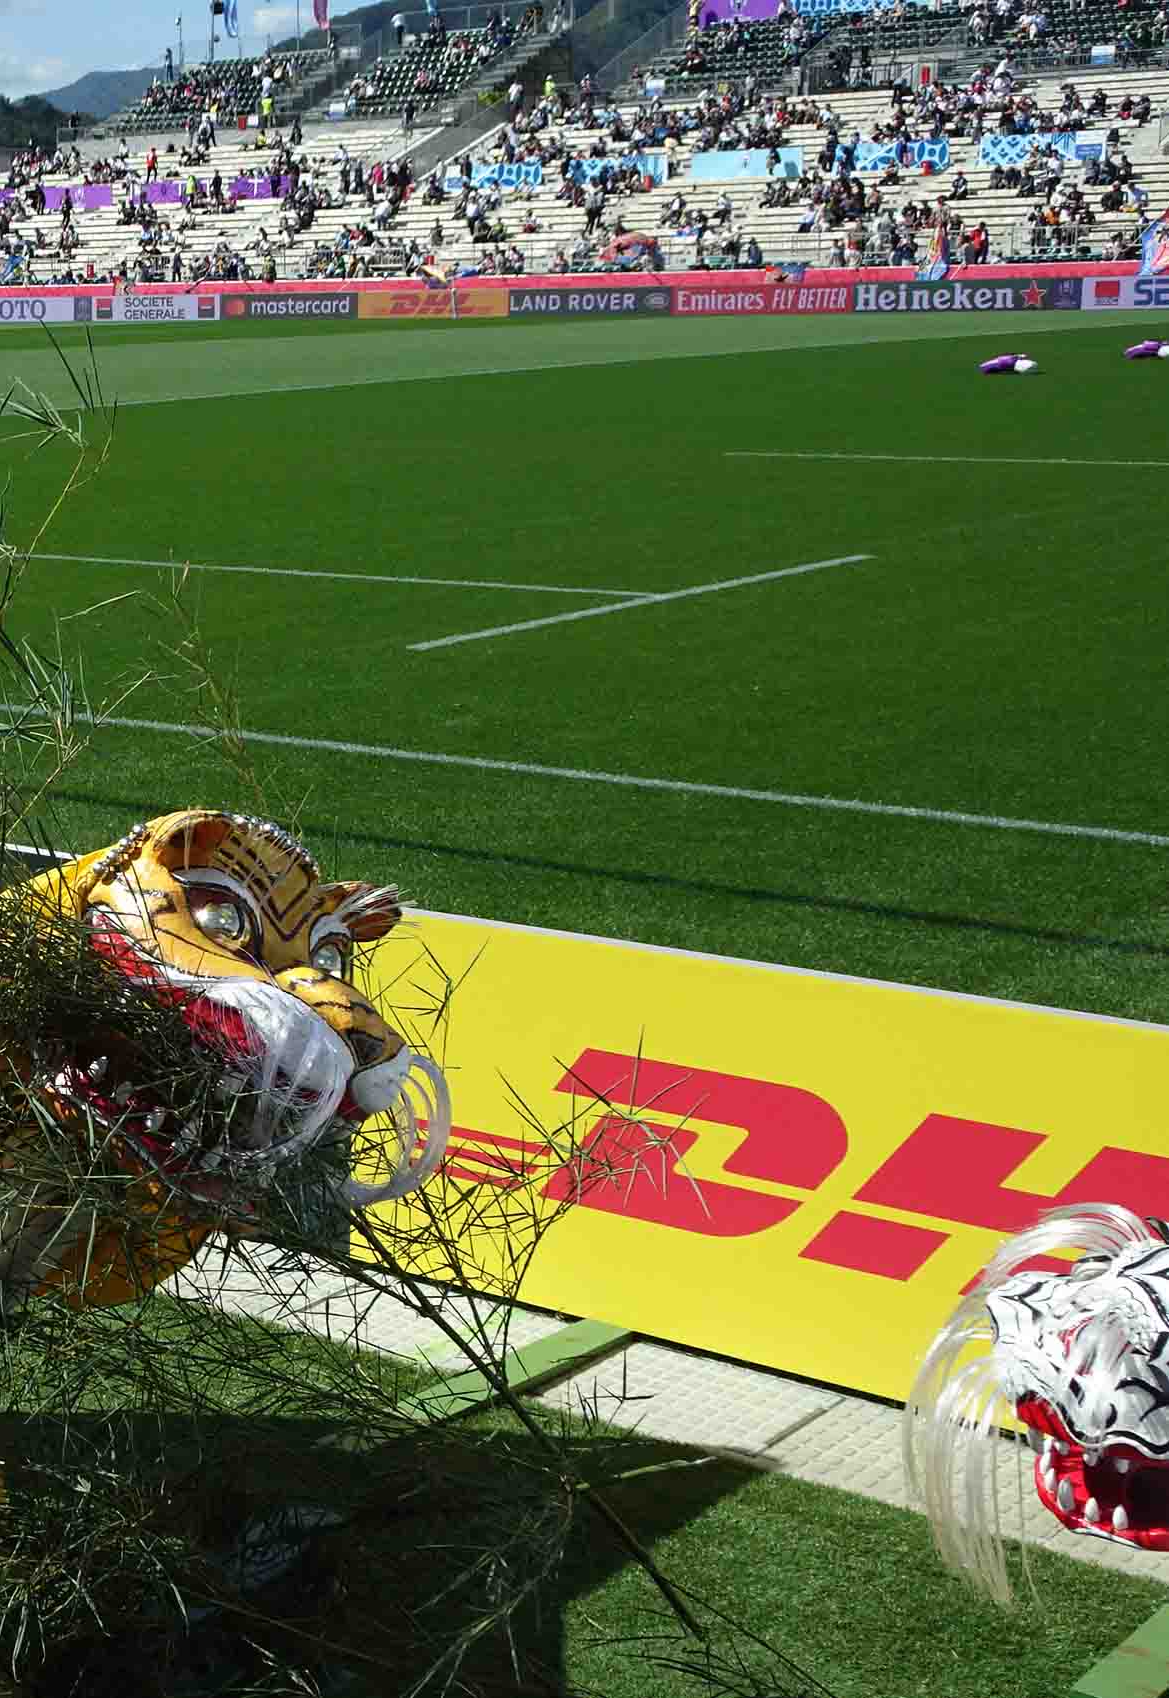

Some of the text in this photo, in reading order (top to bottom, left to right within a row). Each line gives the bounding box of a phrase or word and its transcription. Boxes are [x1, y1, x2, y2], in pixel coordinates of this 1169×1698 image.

[251, 297, 350, 315] mastercard
[388, 293, 478, 315] DHL
[509, 293, 637, 312] LAND ROVER
[677, 287, 848, 311] Emirates FLY BETTER
[854, 283, 1014, 311] Heineken
[124, 308, 185, 320] GENERALE
